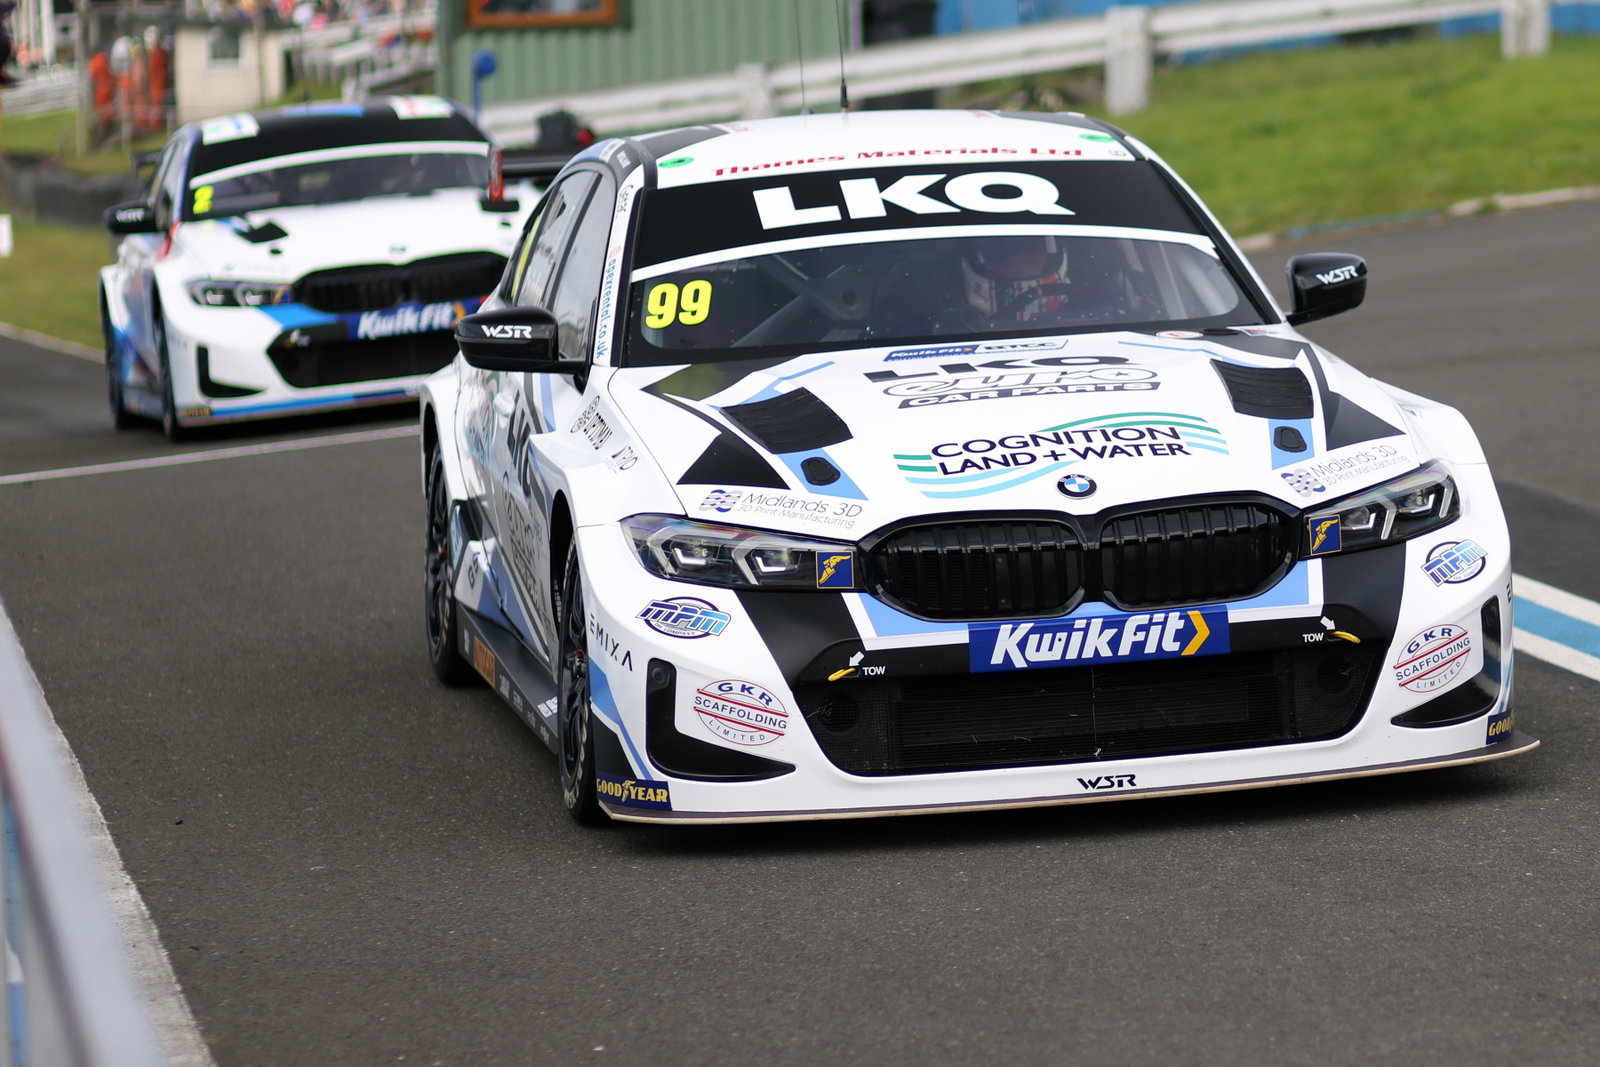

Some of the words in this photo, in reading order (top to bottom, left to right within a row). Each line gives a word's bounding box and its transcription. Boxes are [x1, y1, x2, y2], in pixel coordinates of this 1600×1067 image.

[711, 156, 845, 176] Thames
[857, 147, 1017, 159] Materials
[1030, 147, 1082, 157] Ltd
[752, 171, 1076, 230] LKQ
[1315, 265, 1358, 285] WSR
[596, 258, 617, 359] apexrental.co.uk
[645, 279, 713, 329] 99
[481, 325, 532, 339] WSR
[863, 356, 1140, 383] LKQ
[908, 388, 998, 406] CAR
[1011, 382, 1153, 396] PARTS
[931, 427, 1181, 457] COGNITION
[1310, 451, 1377, 478] Midlands
[1372, 445, 1397, 458] 3D
[737, 503, 751, 513] 3D
[754, 506, 777, 516] Print
[779, 509, 855, 529] Manufacturing
[742, 493, 829, 513] Midlands
[833, 502, 862, 517] 3D
[1302, 632, 1325, 643] TOW
[1407, 627, 1453, 655] GKR
[861, 666, 886, 677] TOW
[1395, 637, 1471, 681] SCAFFOLDING
[1416, 661, 1461, 689] LIMITED
[717, 683, 773, 707] GKR
[694, 696, 788, 729] SCAFFOLDING
[708, 719, 766, 742] LIMITED
[597, 778, 668, 803] GOODYEAR
[1076, 774, 1136, 790] WSR
